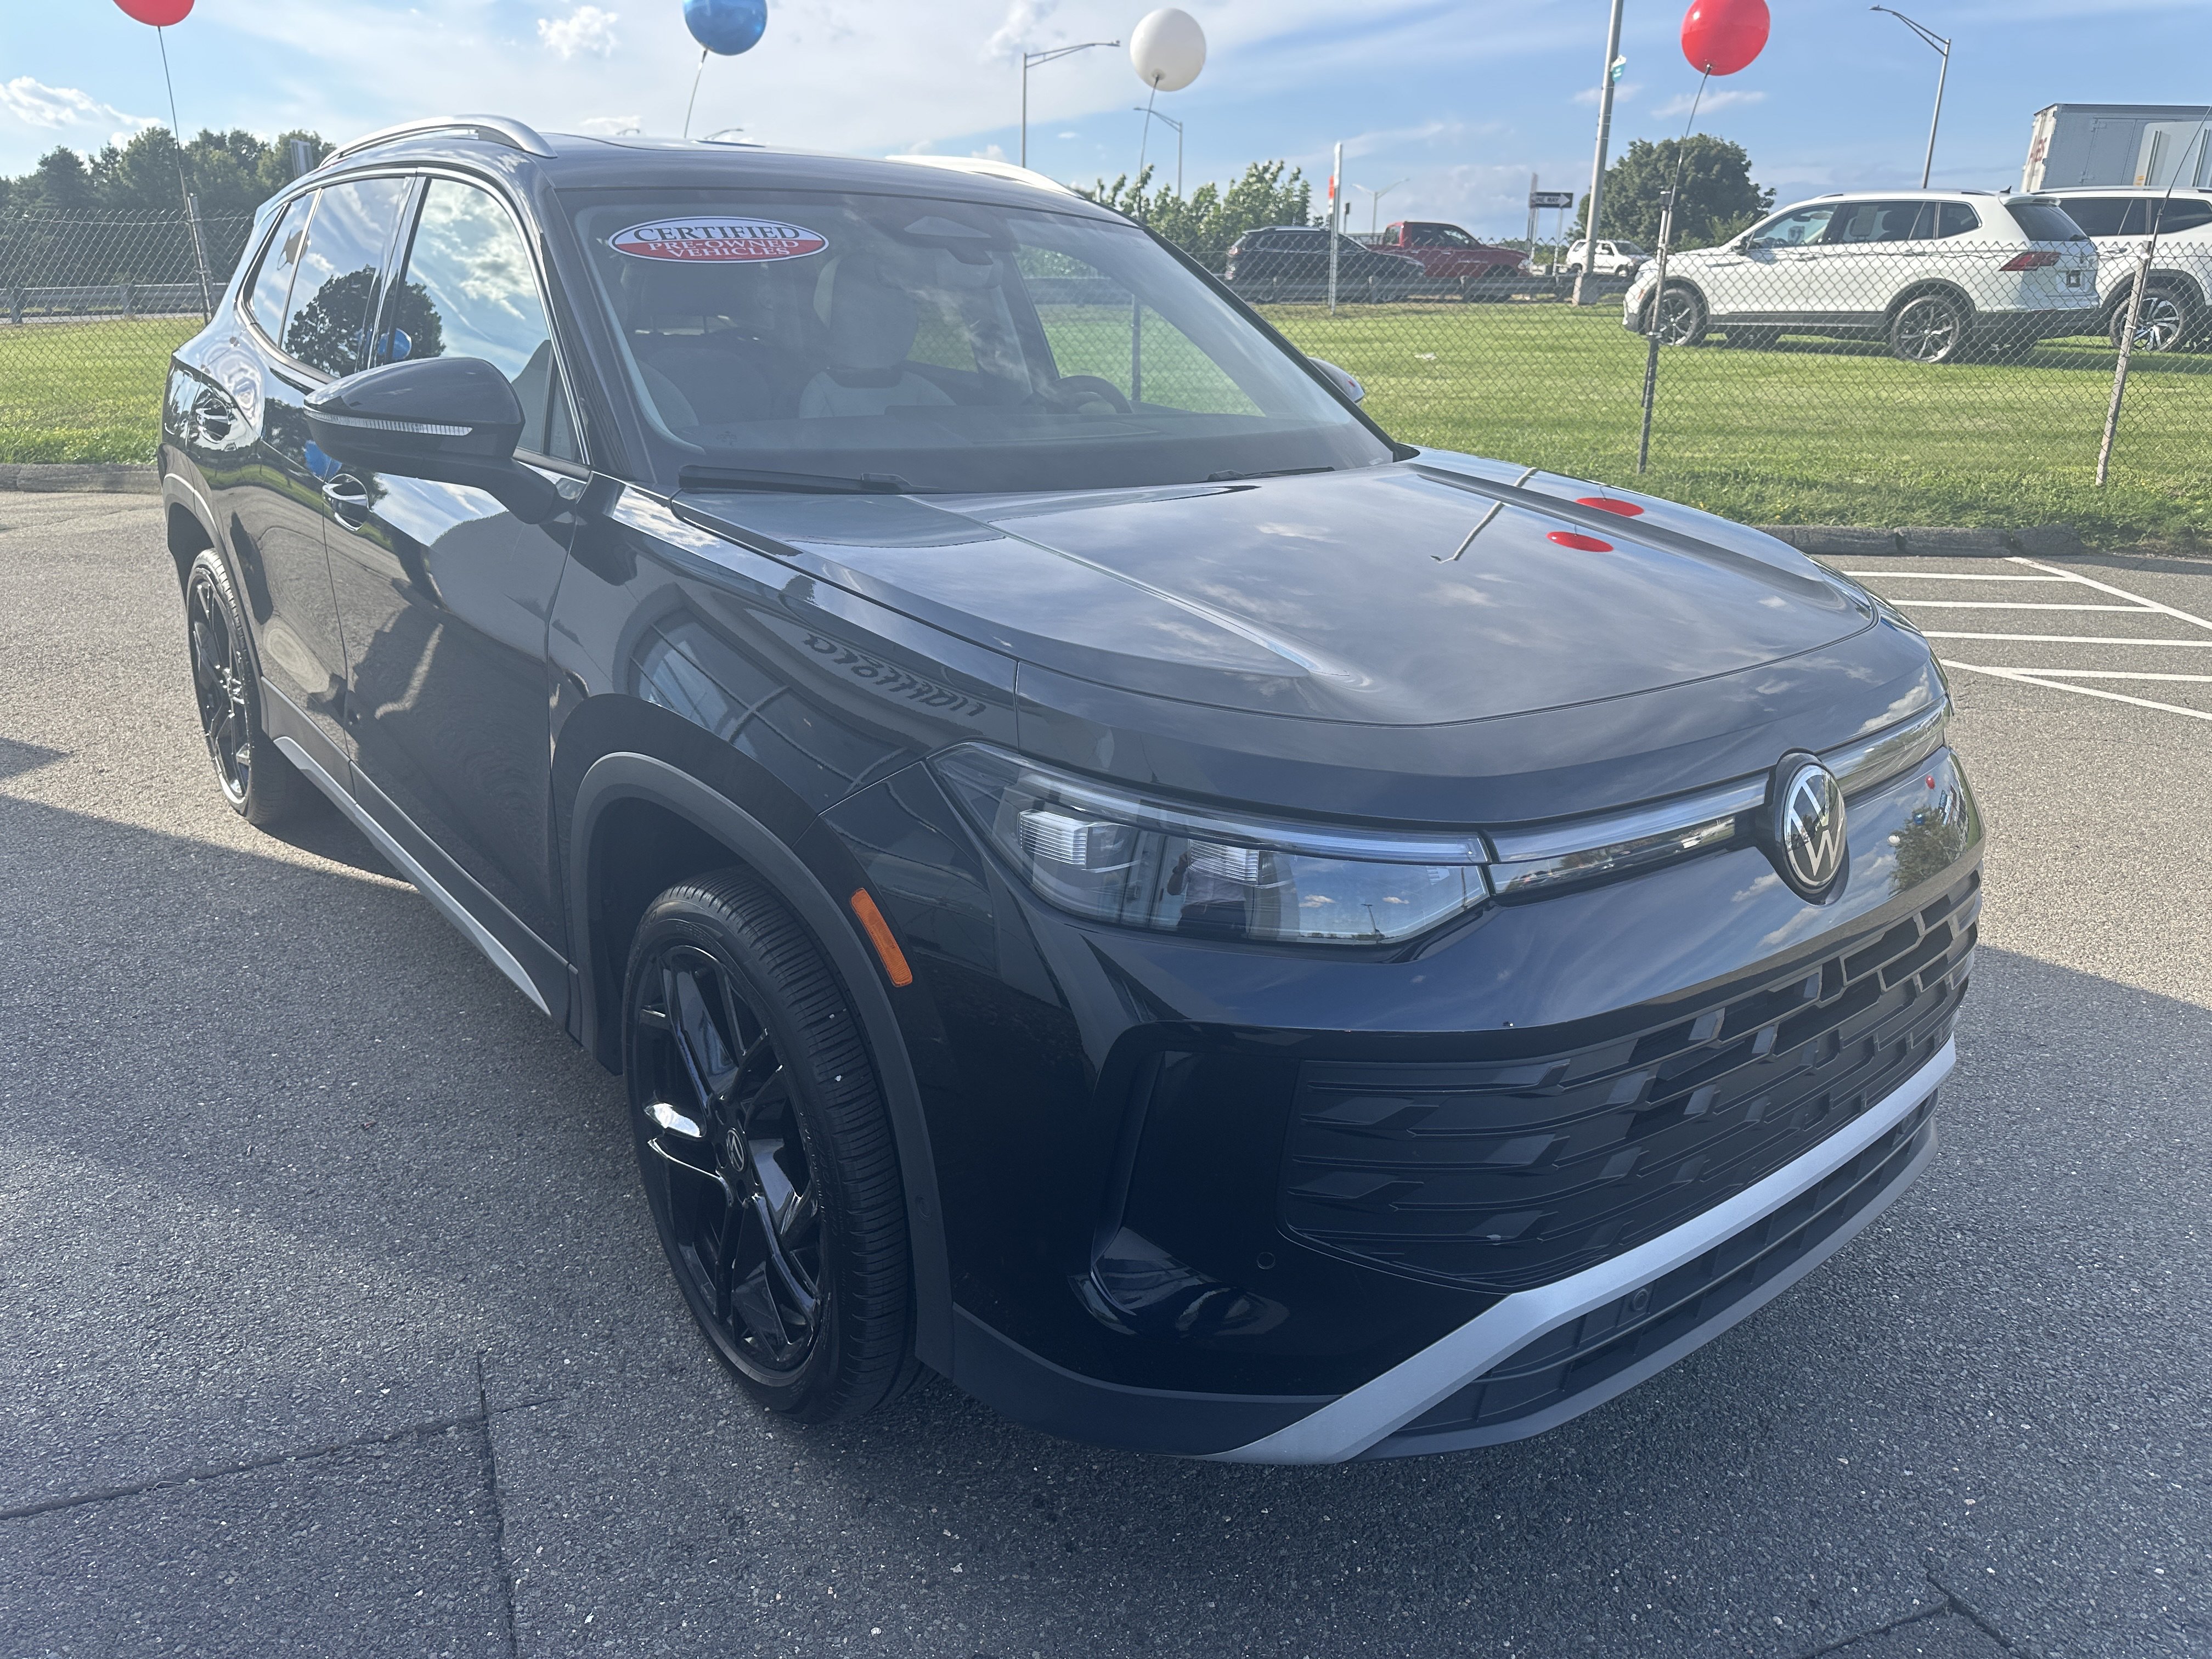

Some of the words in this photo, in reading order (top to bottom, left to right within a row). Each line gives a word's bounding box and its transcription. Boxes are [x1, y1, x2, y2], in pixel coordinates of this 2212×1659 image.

[634, 226, 800, 241] CERTIFIED
[648, 240, 799, 251] PRE-OWNED
[667, 247, 790, 257] VEHICLES
